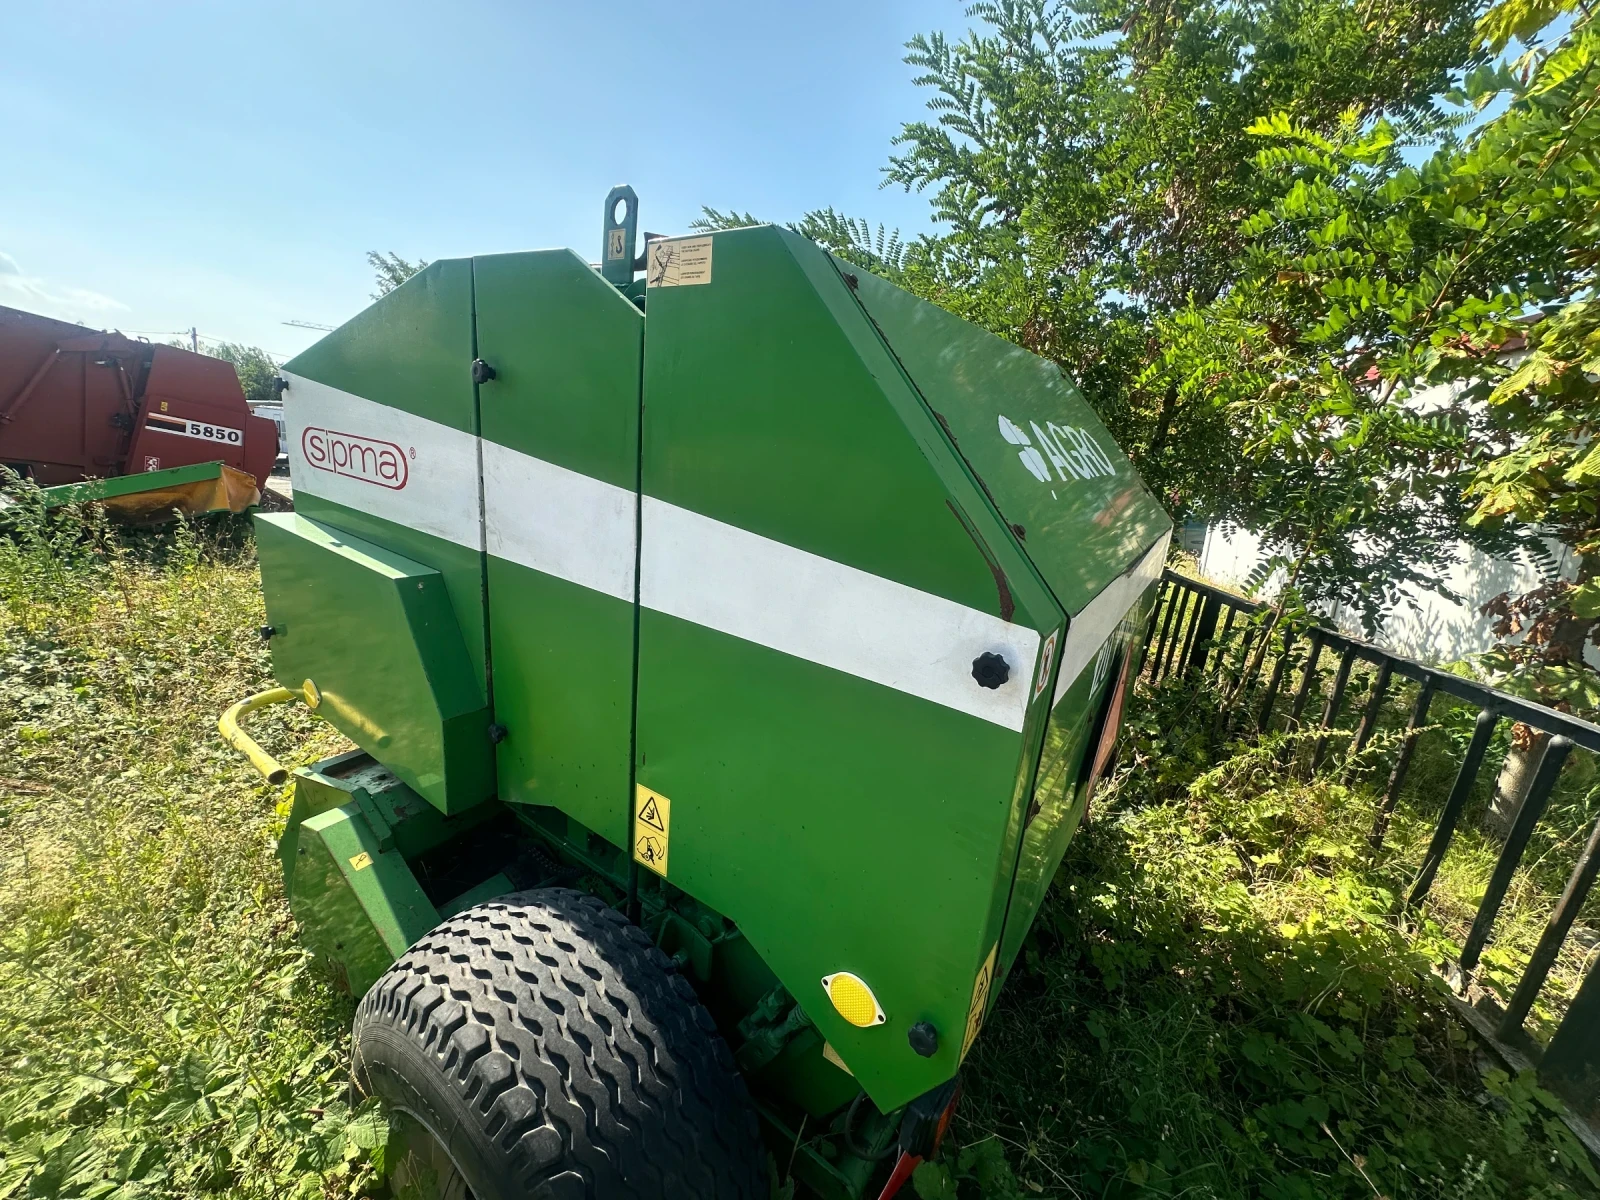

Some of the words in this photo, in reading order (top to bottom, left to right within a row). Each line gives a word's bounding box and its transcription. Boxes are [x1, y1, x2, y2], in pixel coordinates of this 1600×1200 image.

[190, 423, 240, 442] 5850
[310, 430, 398, 481] sipma
[1029, 420, 1116, 482] AGRO
